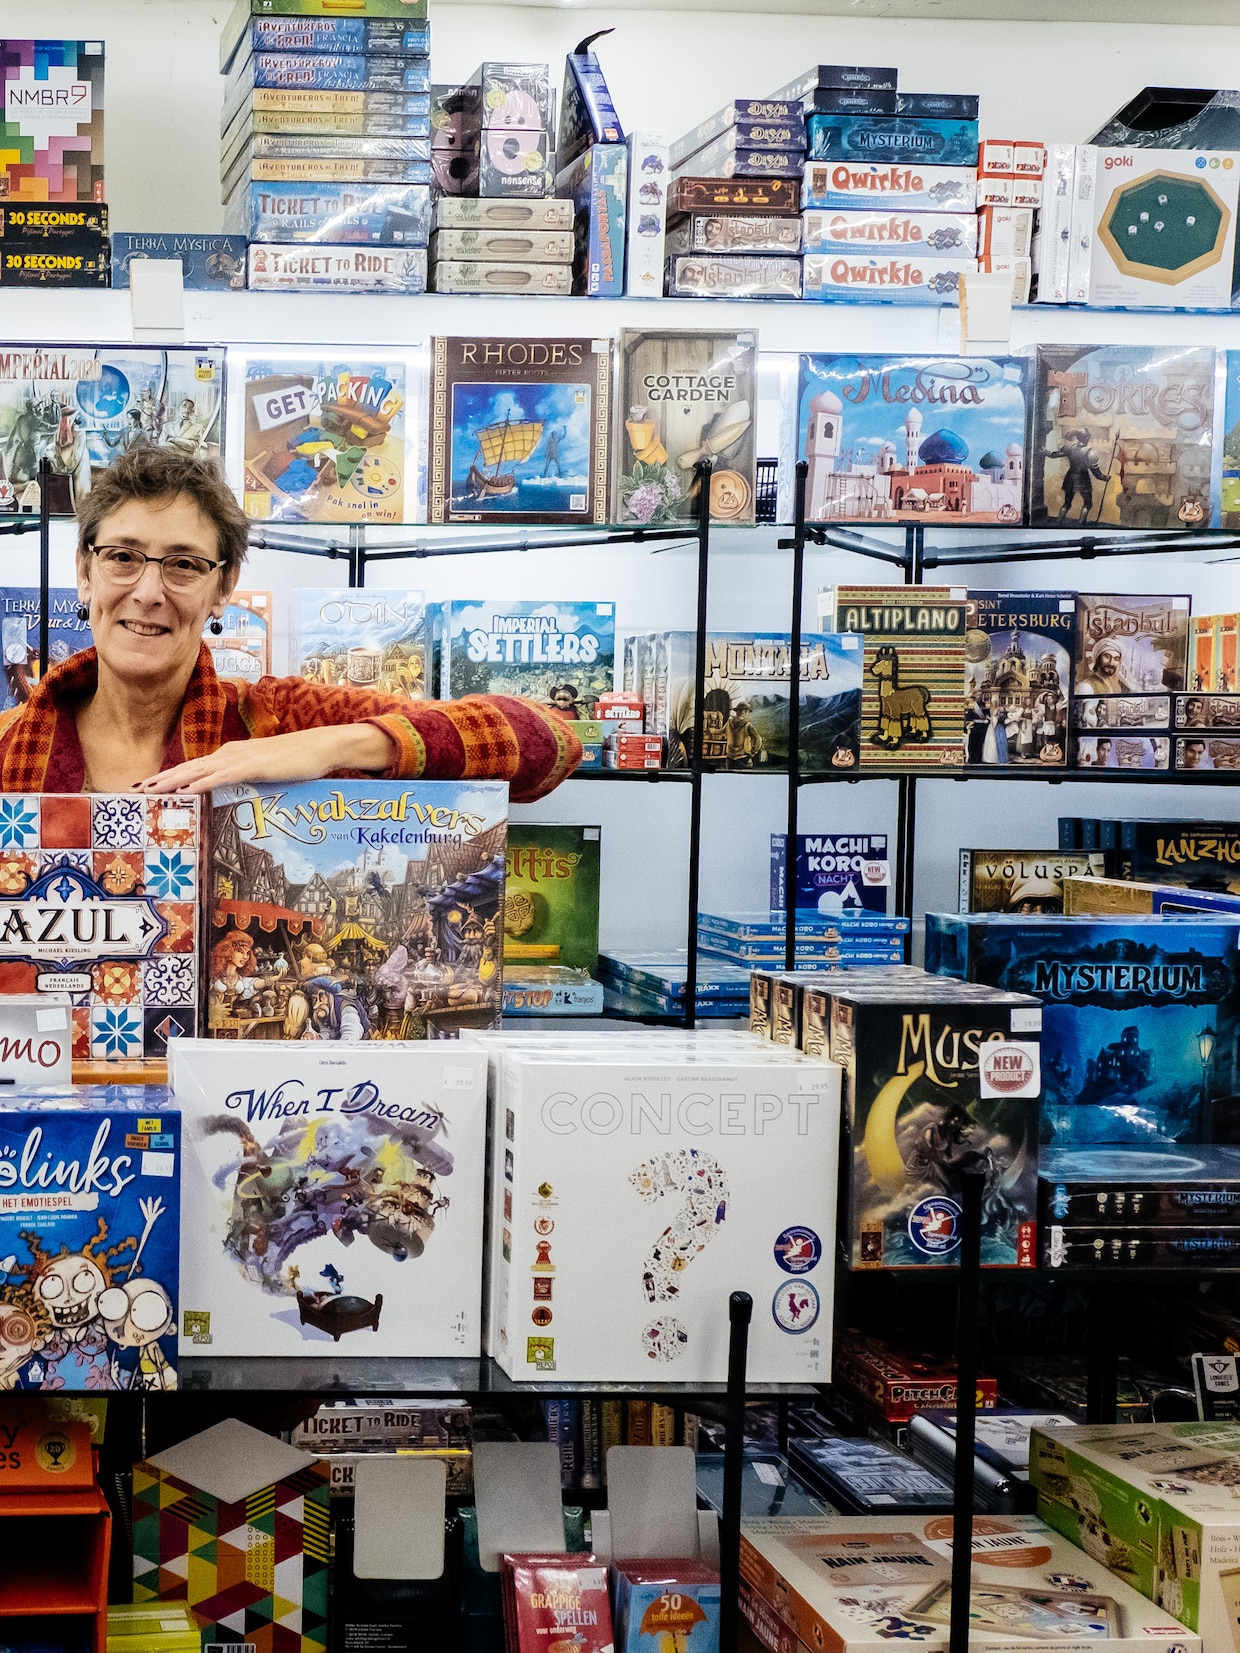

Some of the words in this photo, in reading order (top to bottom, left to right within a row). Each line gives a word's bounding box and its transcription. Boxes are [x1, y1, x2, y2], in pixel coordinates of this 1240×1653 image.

[858, 132, 935, 149] MYSTERIUM
[1104, 155, 1134, 170] goki
[501, 176, 543, 187] nonsense
[831, 166, 924, 194] Qwirkle
[260, 194, 319, 215] TICKET
[323, 199, 339, 210] TO
[9, 212, 33, 226] 30
[33, 212, 85, 226] SECONDS
[281, 217, 316, 228] RAILS
[830, 215, 923, 243] Qwirkle
[124, 236, 167, 251] TERRA
[173, 238, 233, 252] MYSTICA
[6, 255, 30, 269] 30
[31, 255, 82, 269] SECONDS
[272, 252, 332, 275] TICKET
[335, 260, 350, 271] TO
[354, 254, 395, 274] RIDE
[460, 343, 583, 366] RHODES
[71, 359, 102, 381] 2030
[643, 375, 736, 389] COTTAGE
[843, 366, 985, 405] Medina
[316, 377, 402, 417] PACKING
[648, 388, 731, 402] GARDEN
[1048, 370, 1208, 430] TORRES
[265, 390, 307, 421] GET
[327, 494, 343, 506] Pak
[345, 498, 366, 510] snel
[368, 501, 378, 509] in
[376, 508, 397, 521] win!
[319, 600, 412, 625] ODIN
[978, 600, 1003, 611] SINT
[493, 615, 557, 635] IMPERIAL
[845, 606, 960, 630] ALTIPLANO
[1086, 604, 1179, 640] Istanbul
[467, 633, 600, 664] SETTLERS
[232, 791, 488, 845] Kwakzalvers
[330, 831, 349, 842] van
[351, 826, 463, 851] Kakelenburg
[805, 837, 869, 854] MACHI
[808, 855, 863, 873] KORO
[818, 873, 855, 884] NACHT
[44, 982, 85, 990] NEDERLANDS
[49, 976, 80, 984] FRANÇAIS
[1031, 959, 1207, 999] MYSTERIUM
[515, 989, 555, 1009] STOP
[993, 1055, 1023, 1070] NEW
[990, 1070, 1028, 1084] PRODUCT
[224, 1079, 309, 1123] When
[315, 1088, 344, 1112] I
[339, 1079, 438, 1130] Dream
[540, 1091, 820, 1136] CONCEPT
[2, 1197, 18, 1208] HET
[21, 1196, 73, 1208] EMOTIESPEL
[822, 1555, 866, 1569] NAIN
[868, 1552, 934, 1568] JAUNE
[530, 1592, 581, 1610] GRAPPIGE
[659, 1593, 682, 1611] 50
[554, 1609, 597, 1627] SPELLEN
[651, 1611, 669, 1622] toffe
[670, 1610, 694, 1621] ideeën
